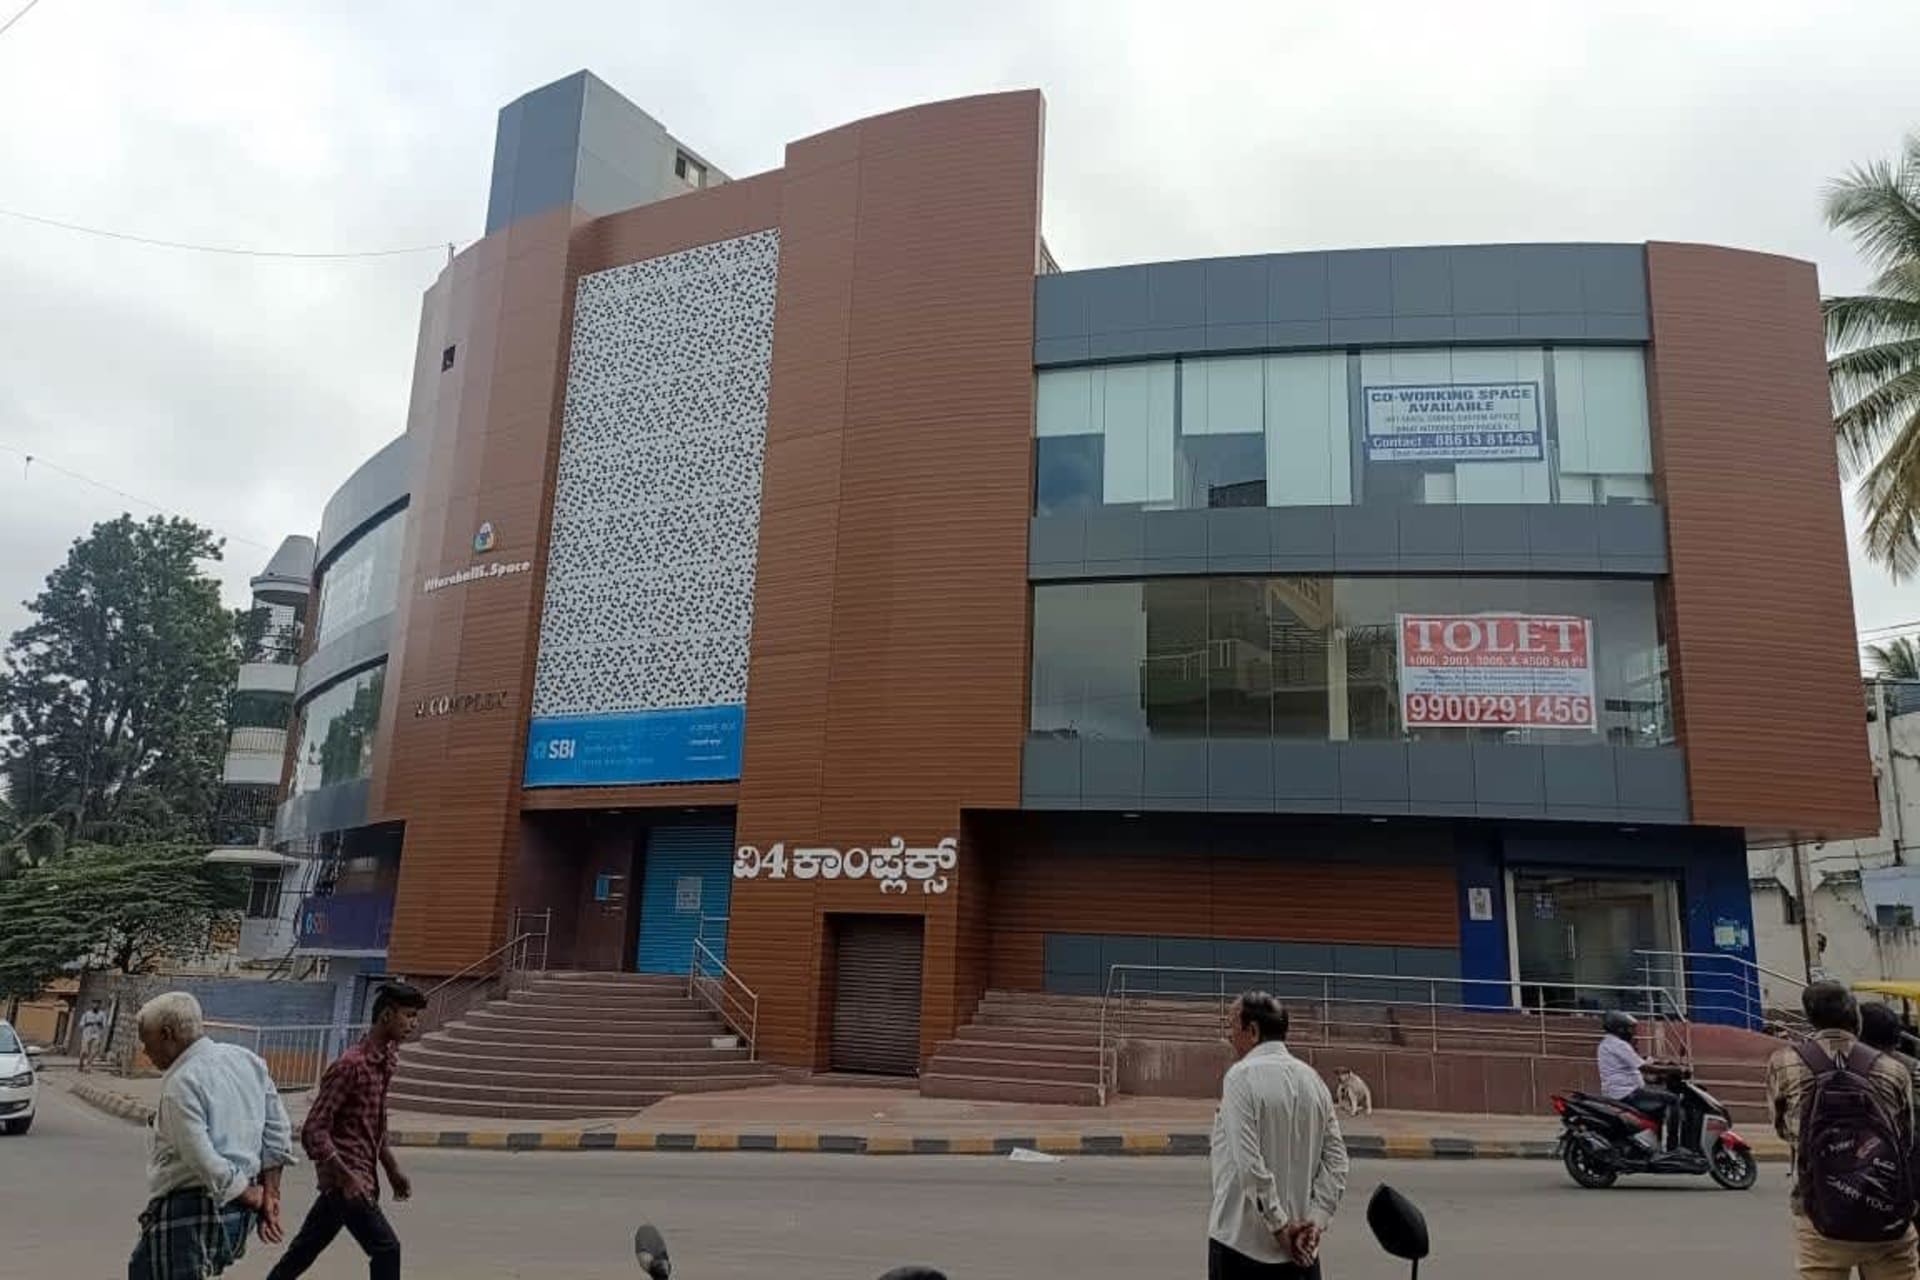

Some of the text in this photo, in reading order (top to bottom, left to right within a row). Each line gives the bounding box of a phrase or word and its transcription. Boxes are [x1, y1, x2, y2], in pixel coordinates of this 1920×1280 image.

[1371, 388, 1532, 402] CO-WORKING SPACE
[1408, 401, 1494, 413] AVAILABLE
[1372, 436, 1422, 449] Contact
[1487, 432, 1534, 446] 81443
[1409, 696, 1590, 722] 9900291456
[549, 739, 576, 760] SBI
